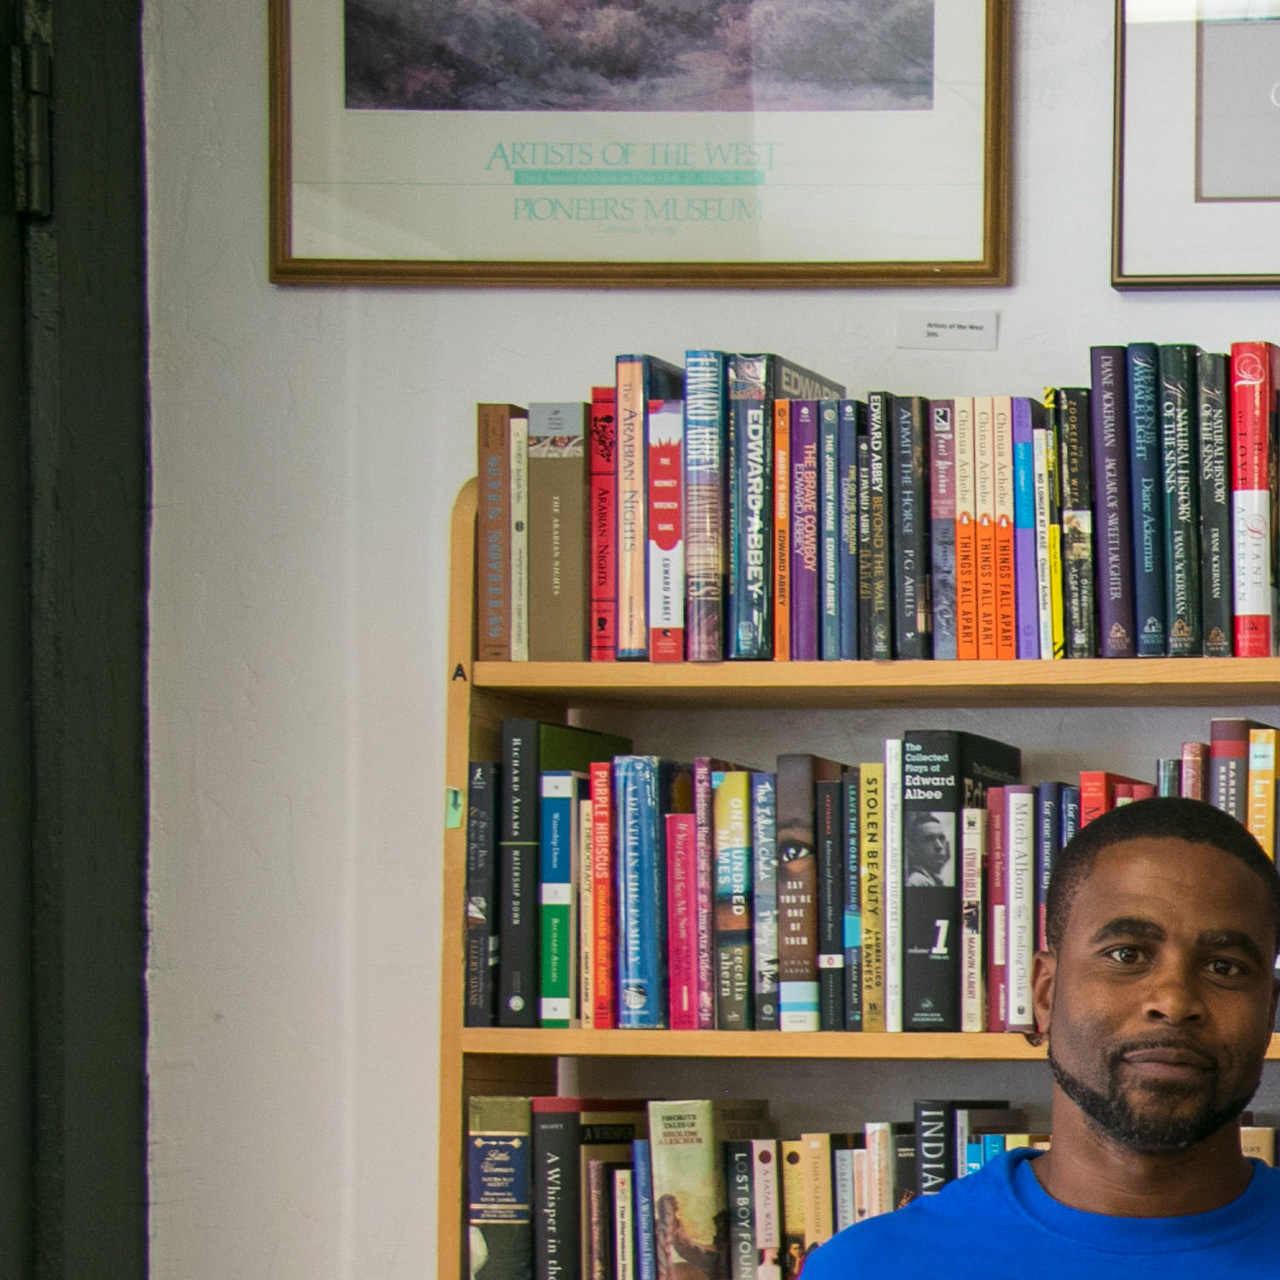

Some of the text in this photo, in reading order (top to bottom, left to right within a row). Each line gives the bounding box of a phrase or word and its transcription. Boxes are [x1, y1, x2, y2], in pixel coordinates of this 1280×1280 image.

[485, 142, 783, 171] ARTISTS OF THE WEST
[513, 197, 763, 221] PIONEERS MUSEUM
[598, 487, 610, 586] ARABIAN NIGHTS
[452, 663, 468, 682] A
[905, 753, 949, 762] Collected
[512, 737, 521, 837] RICHARD ADAMS
[905, 775, 955, 786] Edward
[905, 788, 942, 800] Albee
[595, 770, 608, 879] PURPLE HIBISCUS
[717, 829, 731, 885] NAMES
[729, 798, 744, 916] ONE HUNDRED
[866, 778, 879, 917] STOLEN BEAUTY
[1015, 802, 1029, 900] Mitch Albom
[787, 881, 804, 890] SAY
[784, 936, 808, 946] THEM
[547, 1152, 560, 1164] A
[734, 1153, 748, 1190] LOST
[544, 1167, 561, 1234] Whisper
[736, 1196, 752, 1228] BOY
[548, 1238, 557, 1255] in
